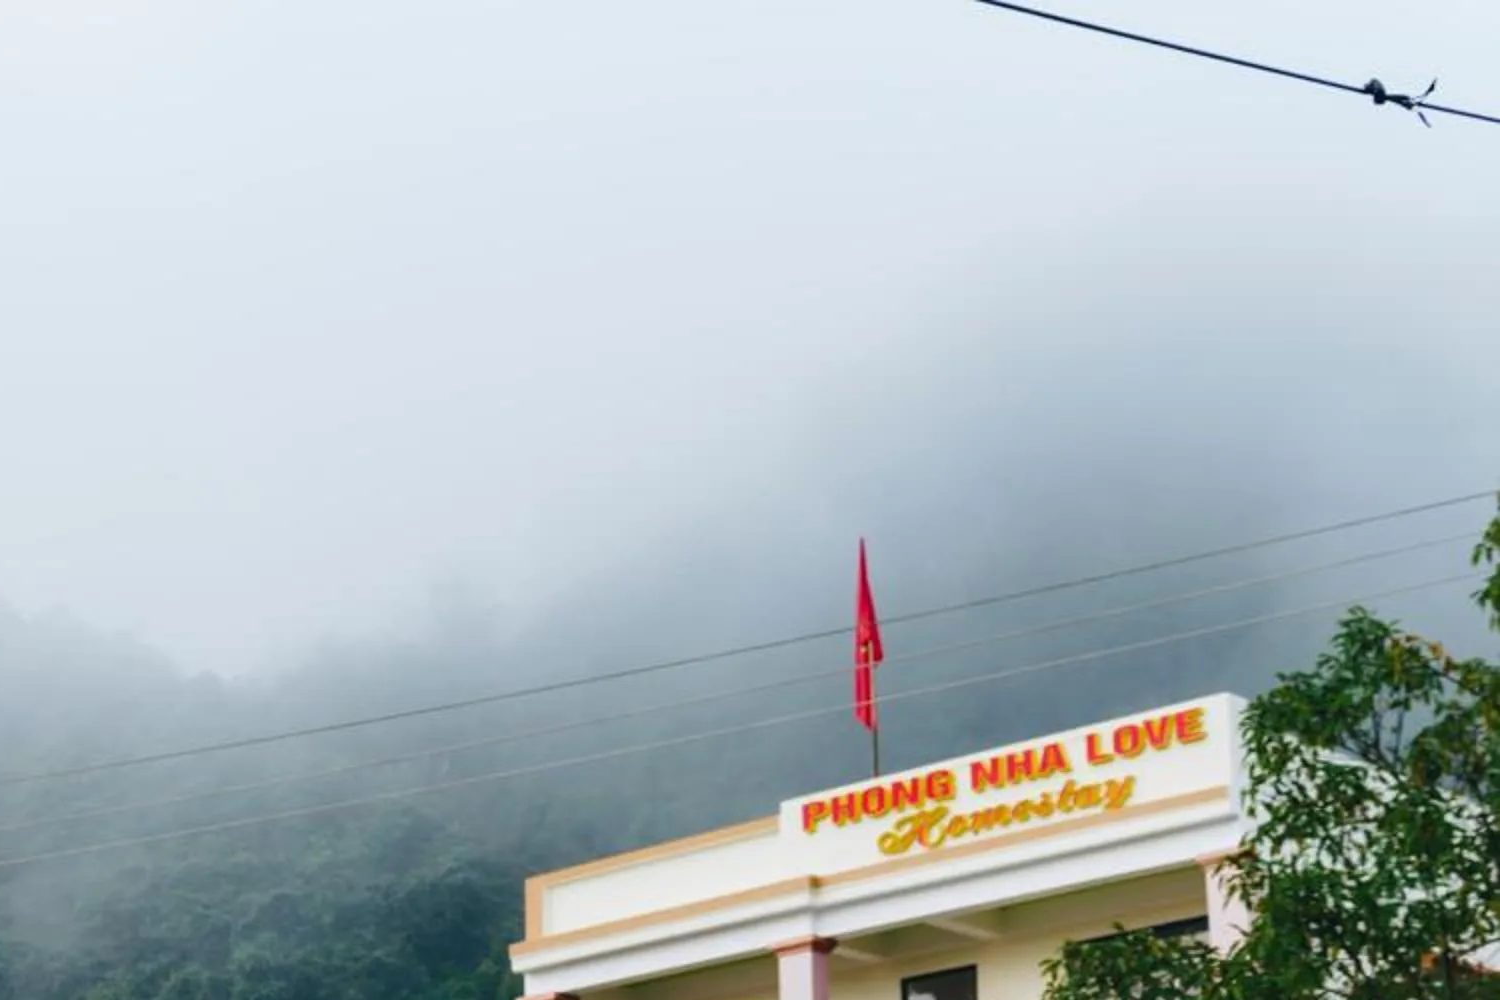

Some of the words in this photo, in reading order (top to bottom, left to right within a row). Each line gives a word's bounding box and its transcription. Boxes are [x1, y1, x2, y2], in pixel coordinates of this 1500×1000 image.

[802, 768, 955, 834] PHONG
[969, 742, 1073, 794] NHA
[1085, 705, 1207, 766] LOVE
[877, 772, 1136, 855] Homestay
